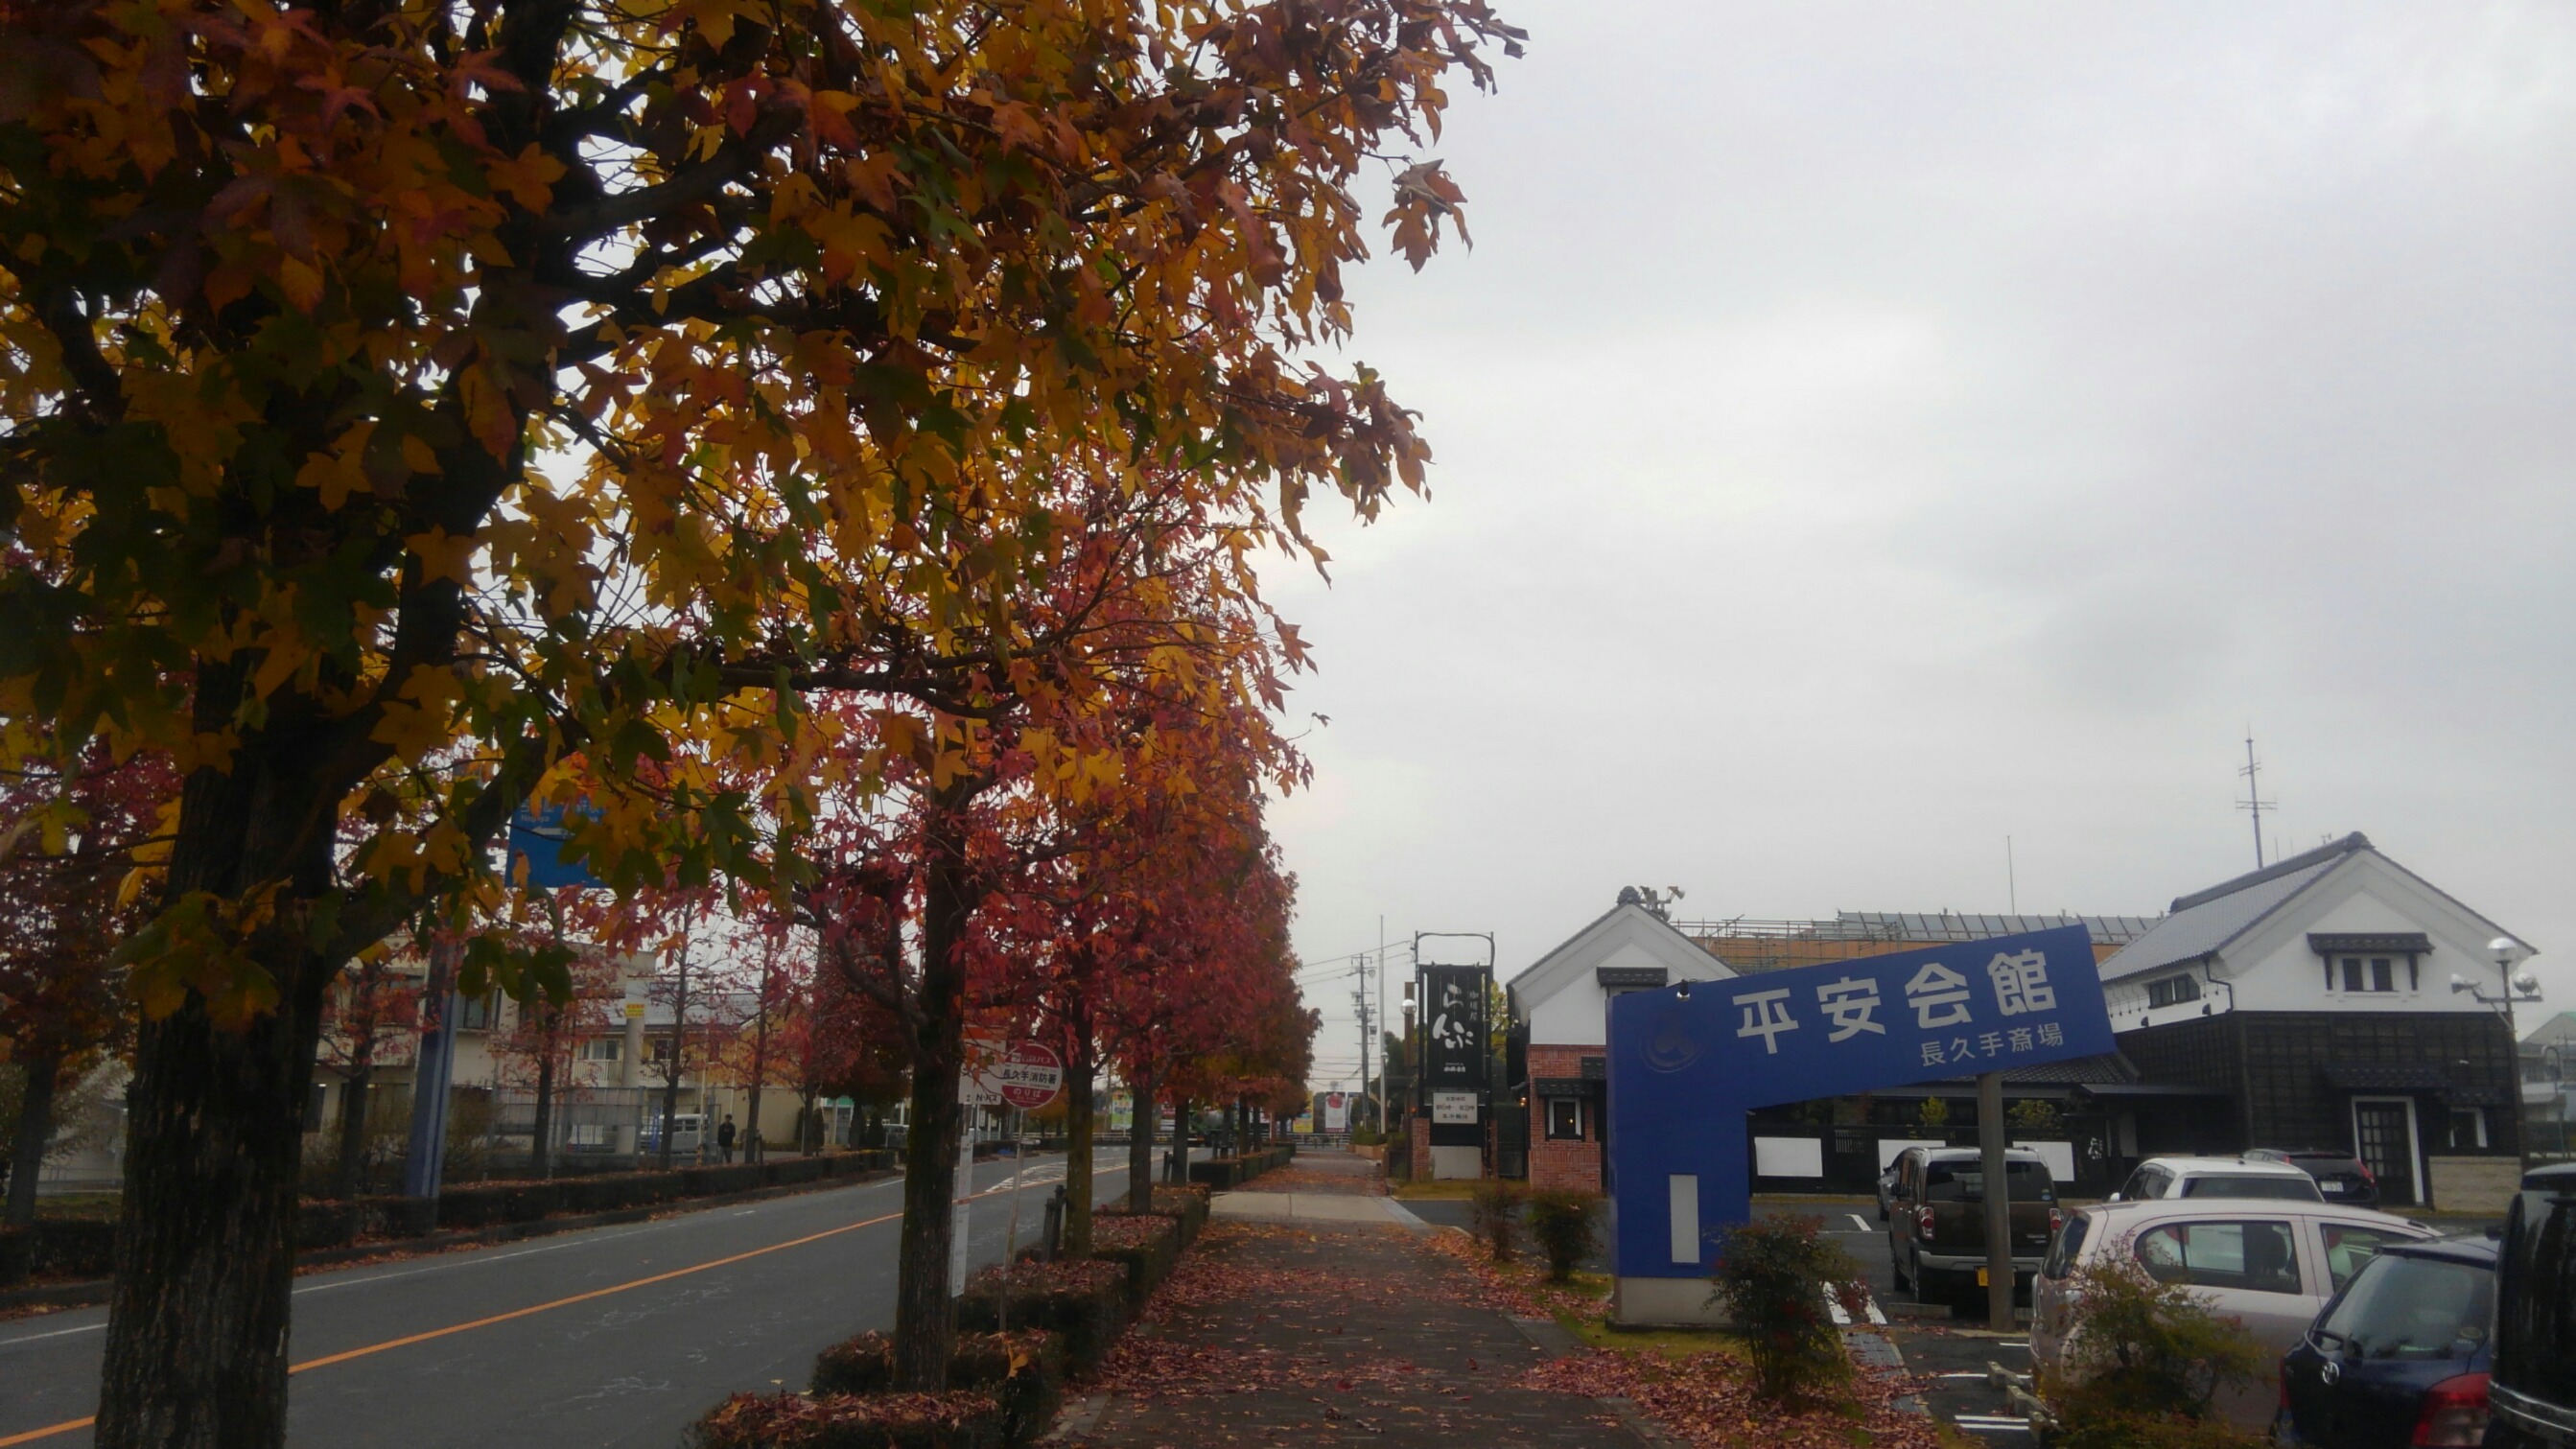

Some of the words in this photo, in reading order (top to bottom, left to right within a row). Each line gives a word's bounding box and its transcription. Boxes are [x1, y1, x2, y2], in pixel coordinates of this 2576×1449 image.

[1732, 947, 2057, 1055] 平安会館
[1920, 1022, 2064, 1067] 長久手斎場
[1003, 1068, 1057, 1085] 長久手消防署
[1013, 1087, 1042, 1098] のりば
